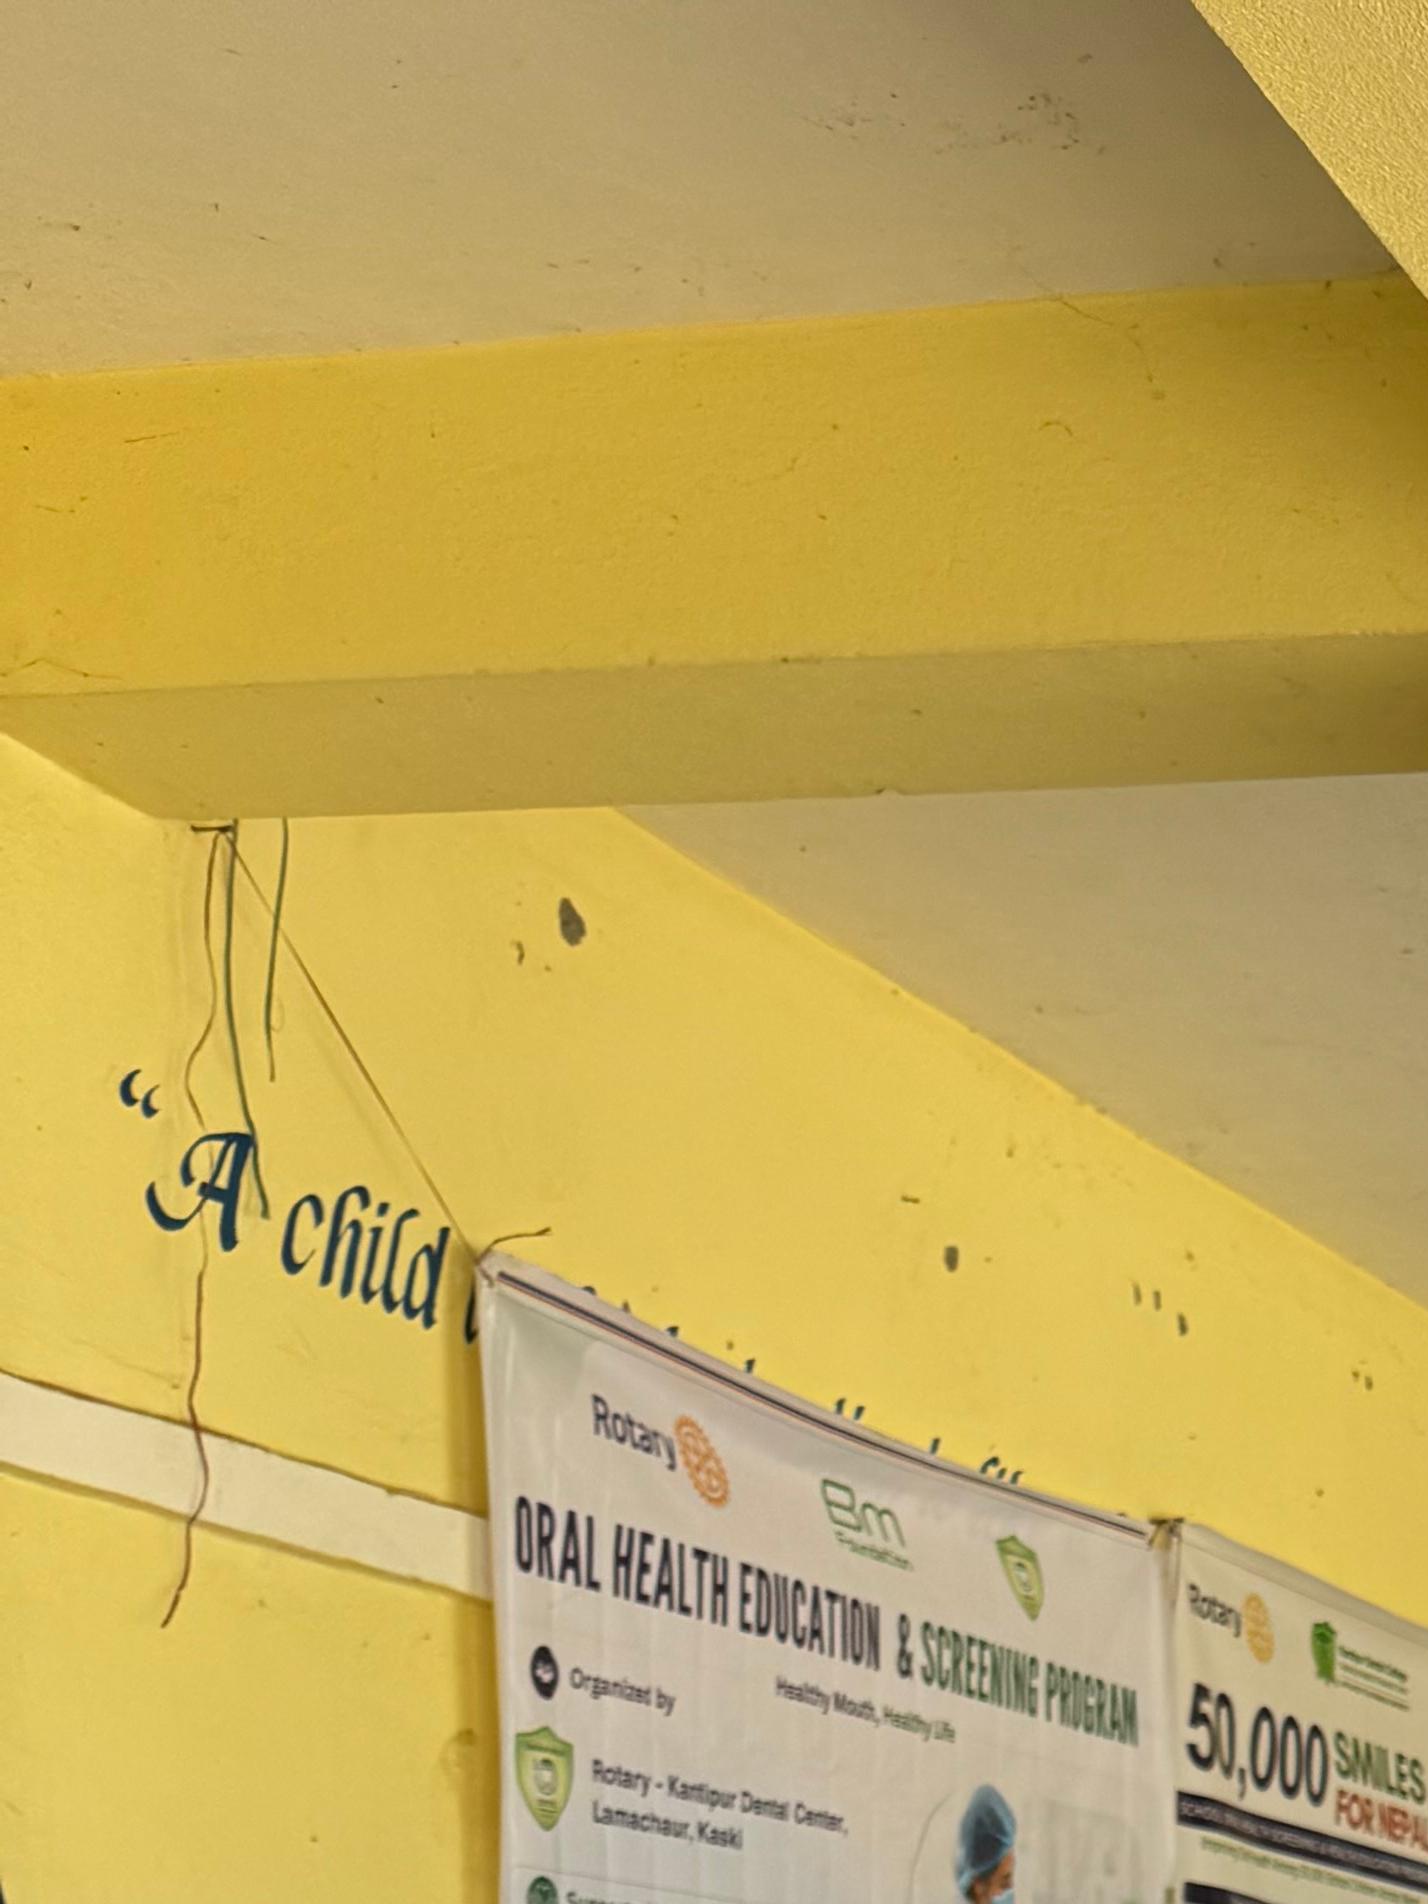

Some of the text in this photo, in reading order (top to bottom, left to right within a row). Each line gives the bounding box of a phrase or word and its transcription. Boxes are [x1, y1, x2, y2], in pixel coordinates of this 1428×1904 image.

[281, 1185, 450, 1329] child
[592, 1395, 676, 1471] Rotary
[514, 1496, 1139, 1747] ORAL HEALTH EDUCATION & SCREENING PROGRAM
[569, 1667, 677, 1716] Organized by
[775, 1675, 831, 1715] Healthy
[882, 1705, 933, 1741] Healthy
[933, 1719, 956, 1743] Life
[1185, 1682, 1329, 1808] 50,000
[1333, 1731, 1428, 1806] SMILES
[591, 1759, 652, 1797] Rotary
[667, 1775, 737, 1811] Kantipur
[742, 1791, 789, 1821] Dental
[1335, 1789, 1376, 1835] FOR
[697, 1821, 743, 1850] Kaski
